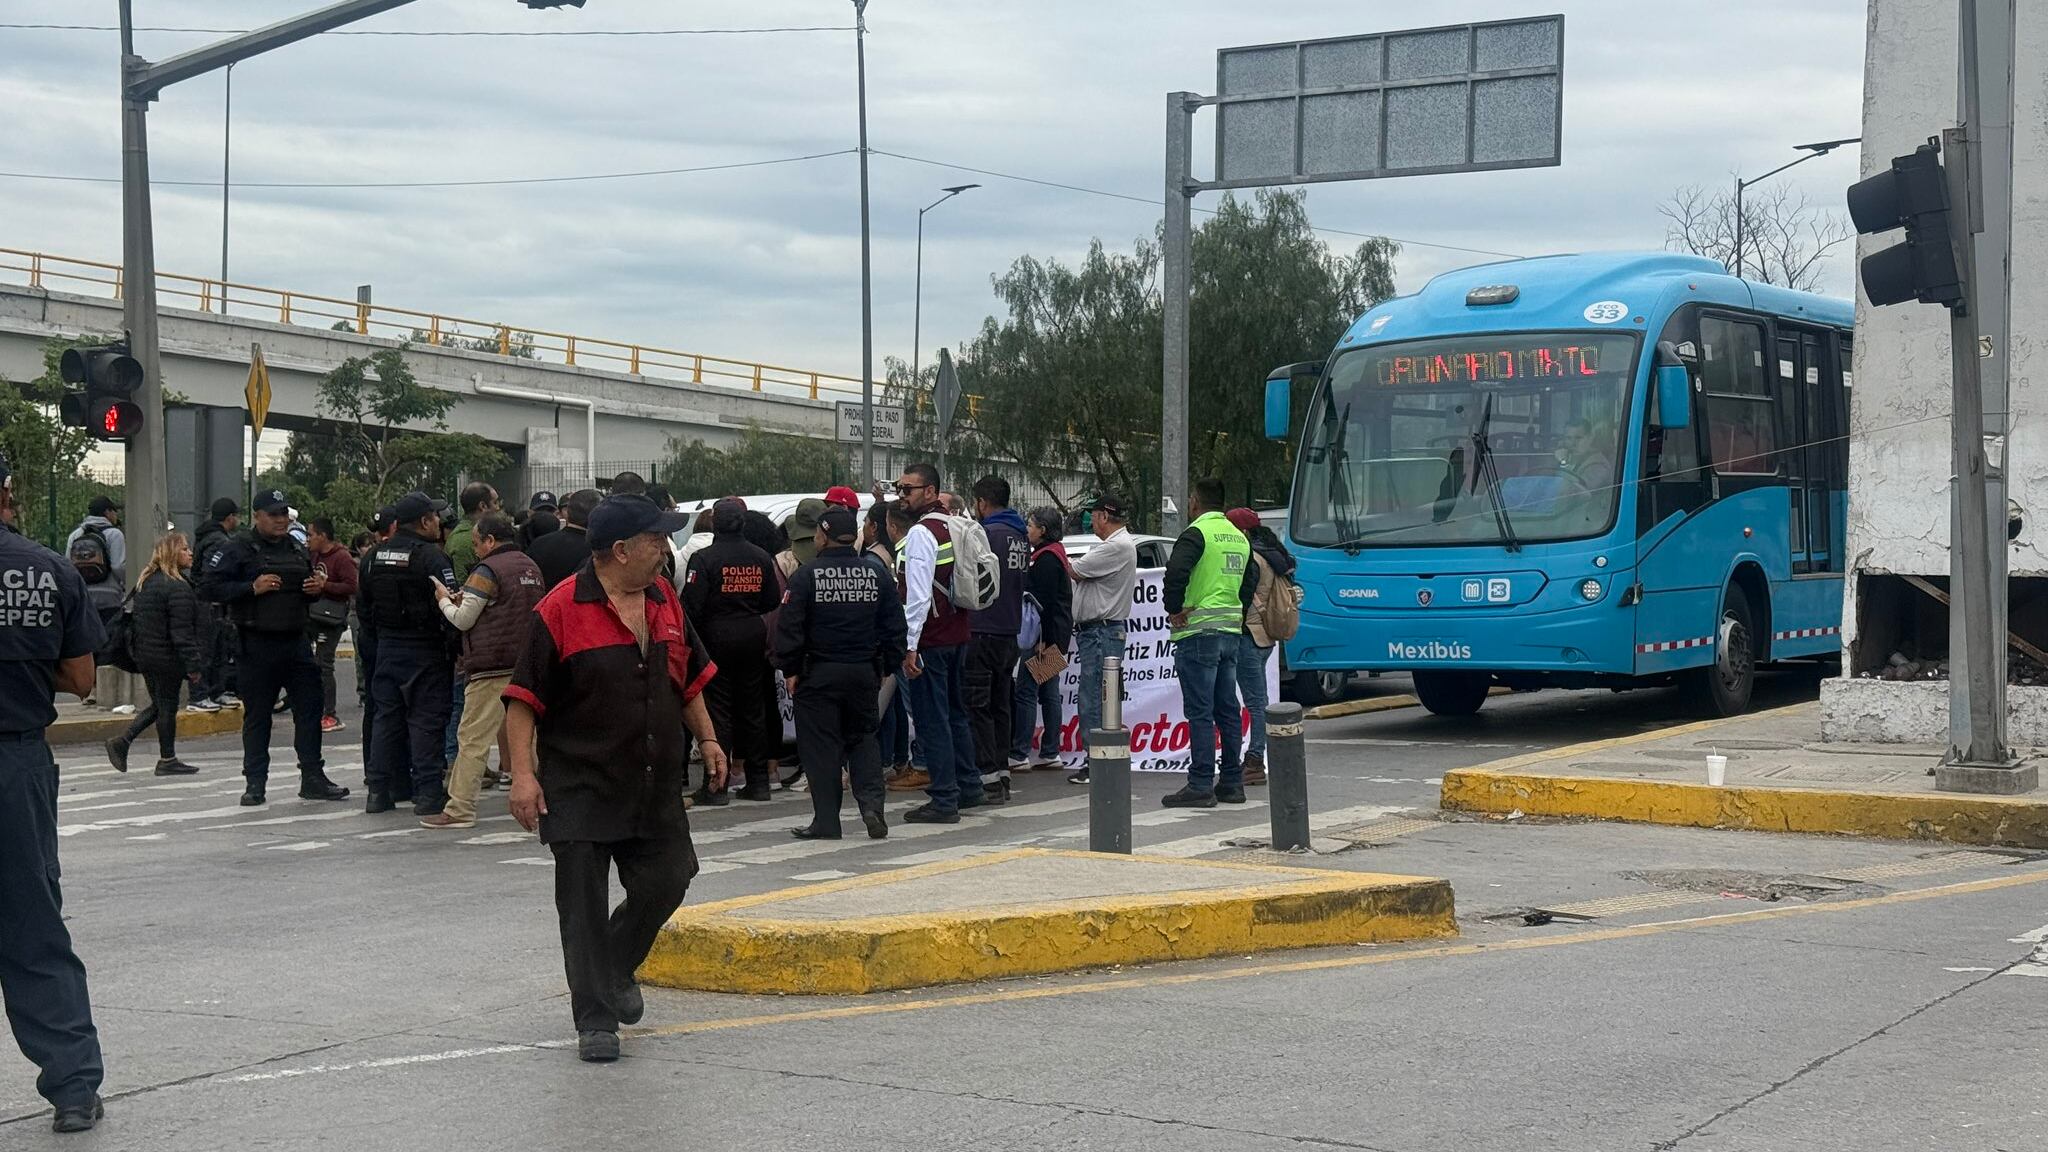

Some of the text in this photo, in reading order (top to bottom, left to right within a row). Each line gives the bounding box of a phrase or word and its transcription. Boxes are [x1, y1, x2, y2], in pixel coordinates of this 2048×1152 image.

[1590, 309, 1620, 320] 33
[876, 410, 883, 422] EL
[885, 411, 899, 423] PASO
[872, 426, 894, 439] EDERAL
[722, 565, 763, 576] POLICÍA
[813, 566, 878, 579] POLICÍA
[721, 584, 762, 593] ECATEPEC
[815, 579, 879, 591] MUNICIPAL
[815, 591, 879, 602] ECATEPEC
[1133, 579, 1158, 604] de
[1338, 588, 1379, 599] SCANIA
[1387, 640, 1472, 659] Mexibús
